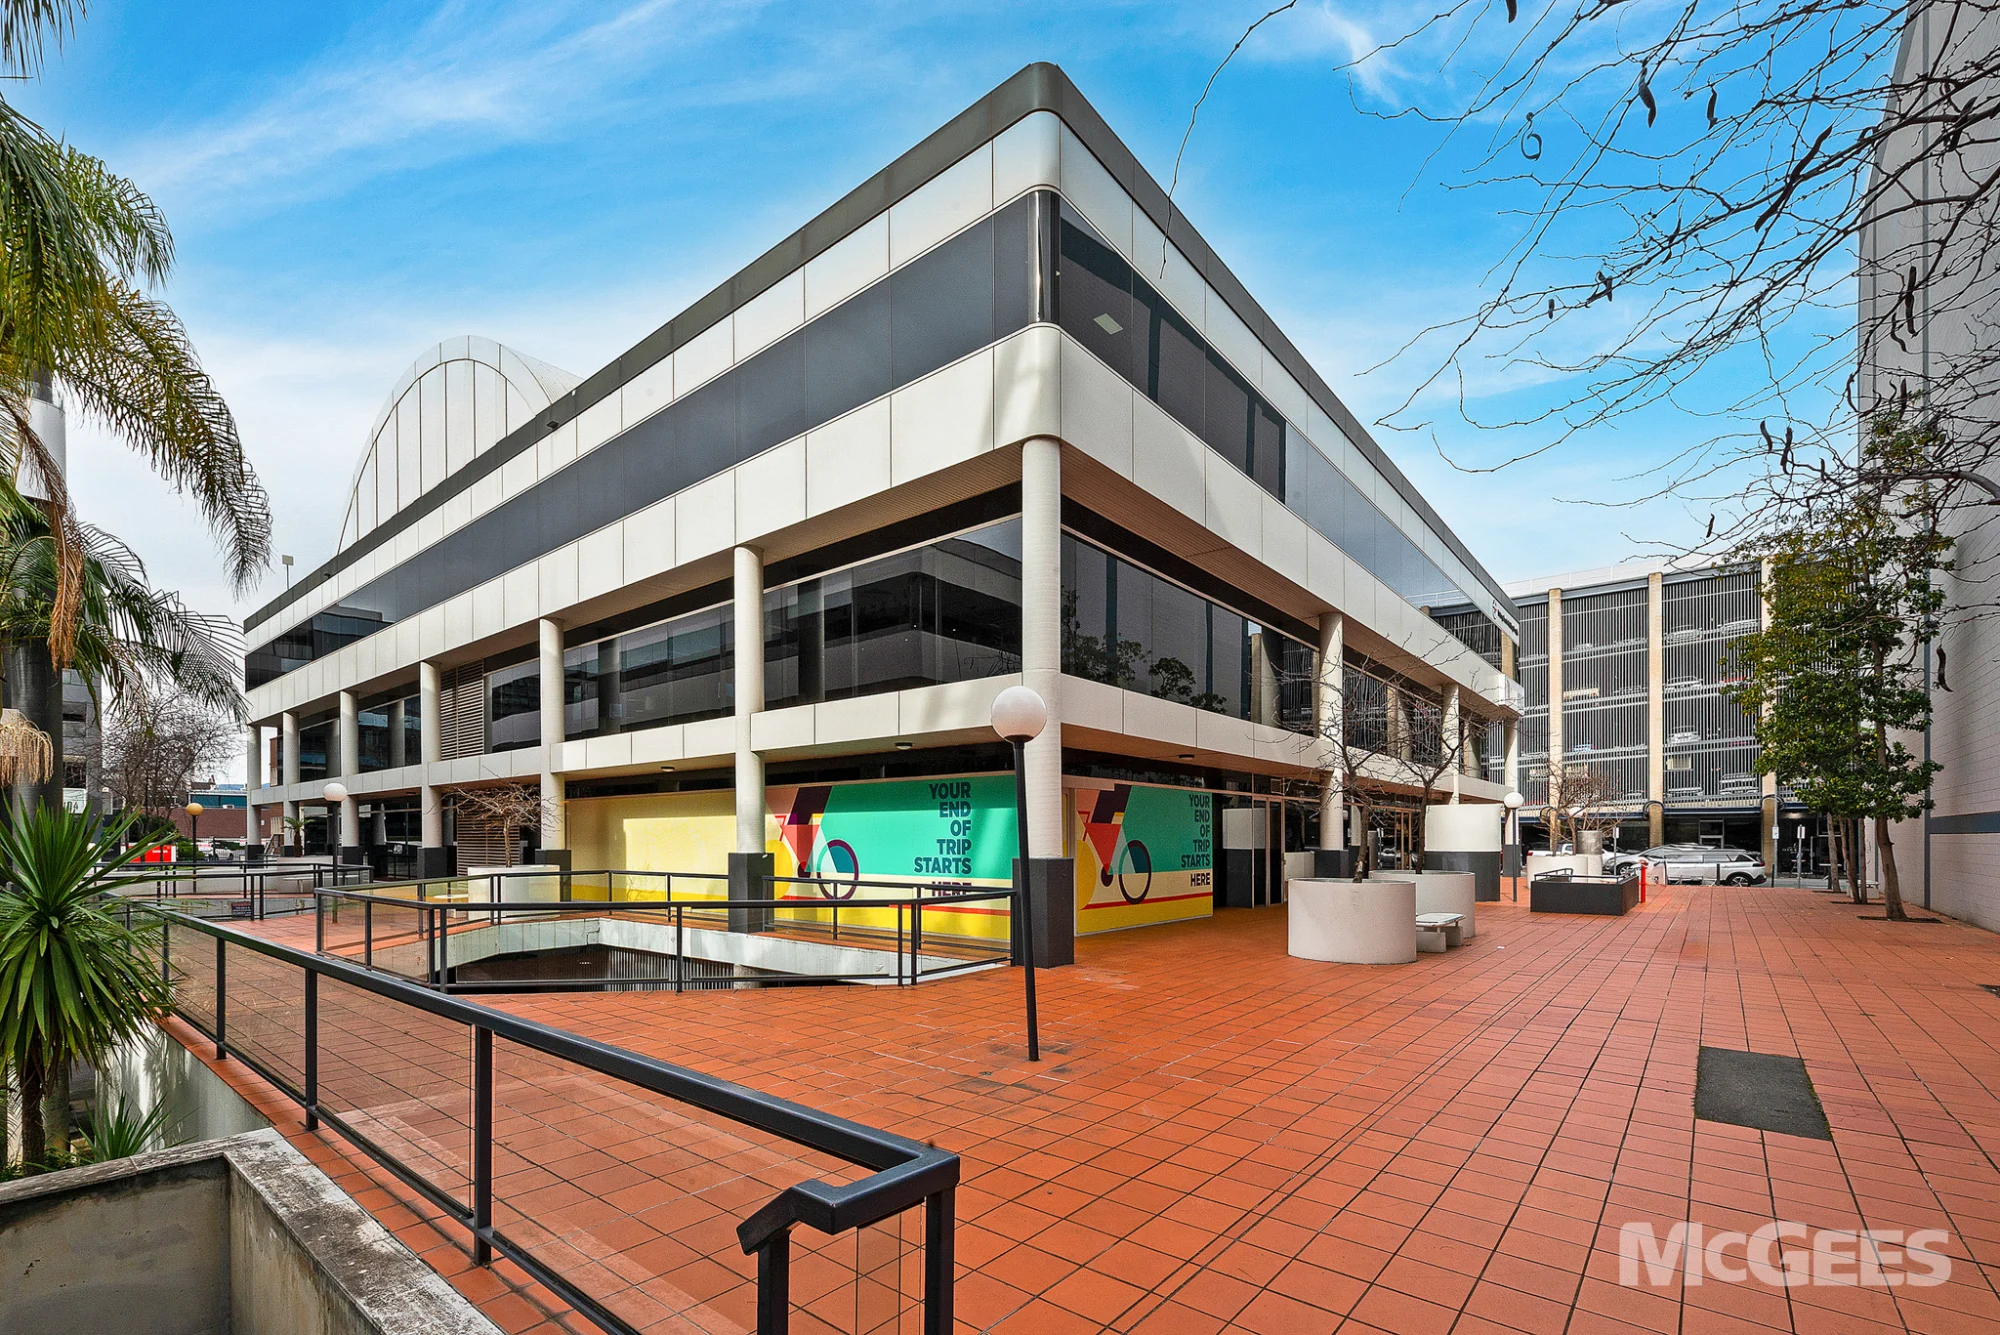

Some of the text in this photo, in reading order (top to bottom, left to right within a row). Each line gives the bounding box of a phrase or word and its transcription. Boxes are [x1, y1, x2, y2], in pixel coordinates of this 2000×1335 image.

[928, 781, 972, 800] YOUR
[1188, 793, 1210, 808] YOUR
[939, 801, 972, 818] END
[1194, 809, 1210, 823] END
[950, 819, 972, 837] OF
[1199, 823, 1211, 838] OF
[936, 838, 972, 855] TRIP
[1193, 839, 1211, 853] TRIP
[914, 856, 972, 875] STARTS
[1181, 853, 1211, 868] STARTS
[1190, 872, 1211, 887] HERE
